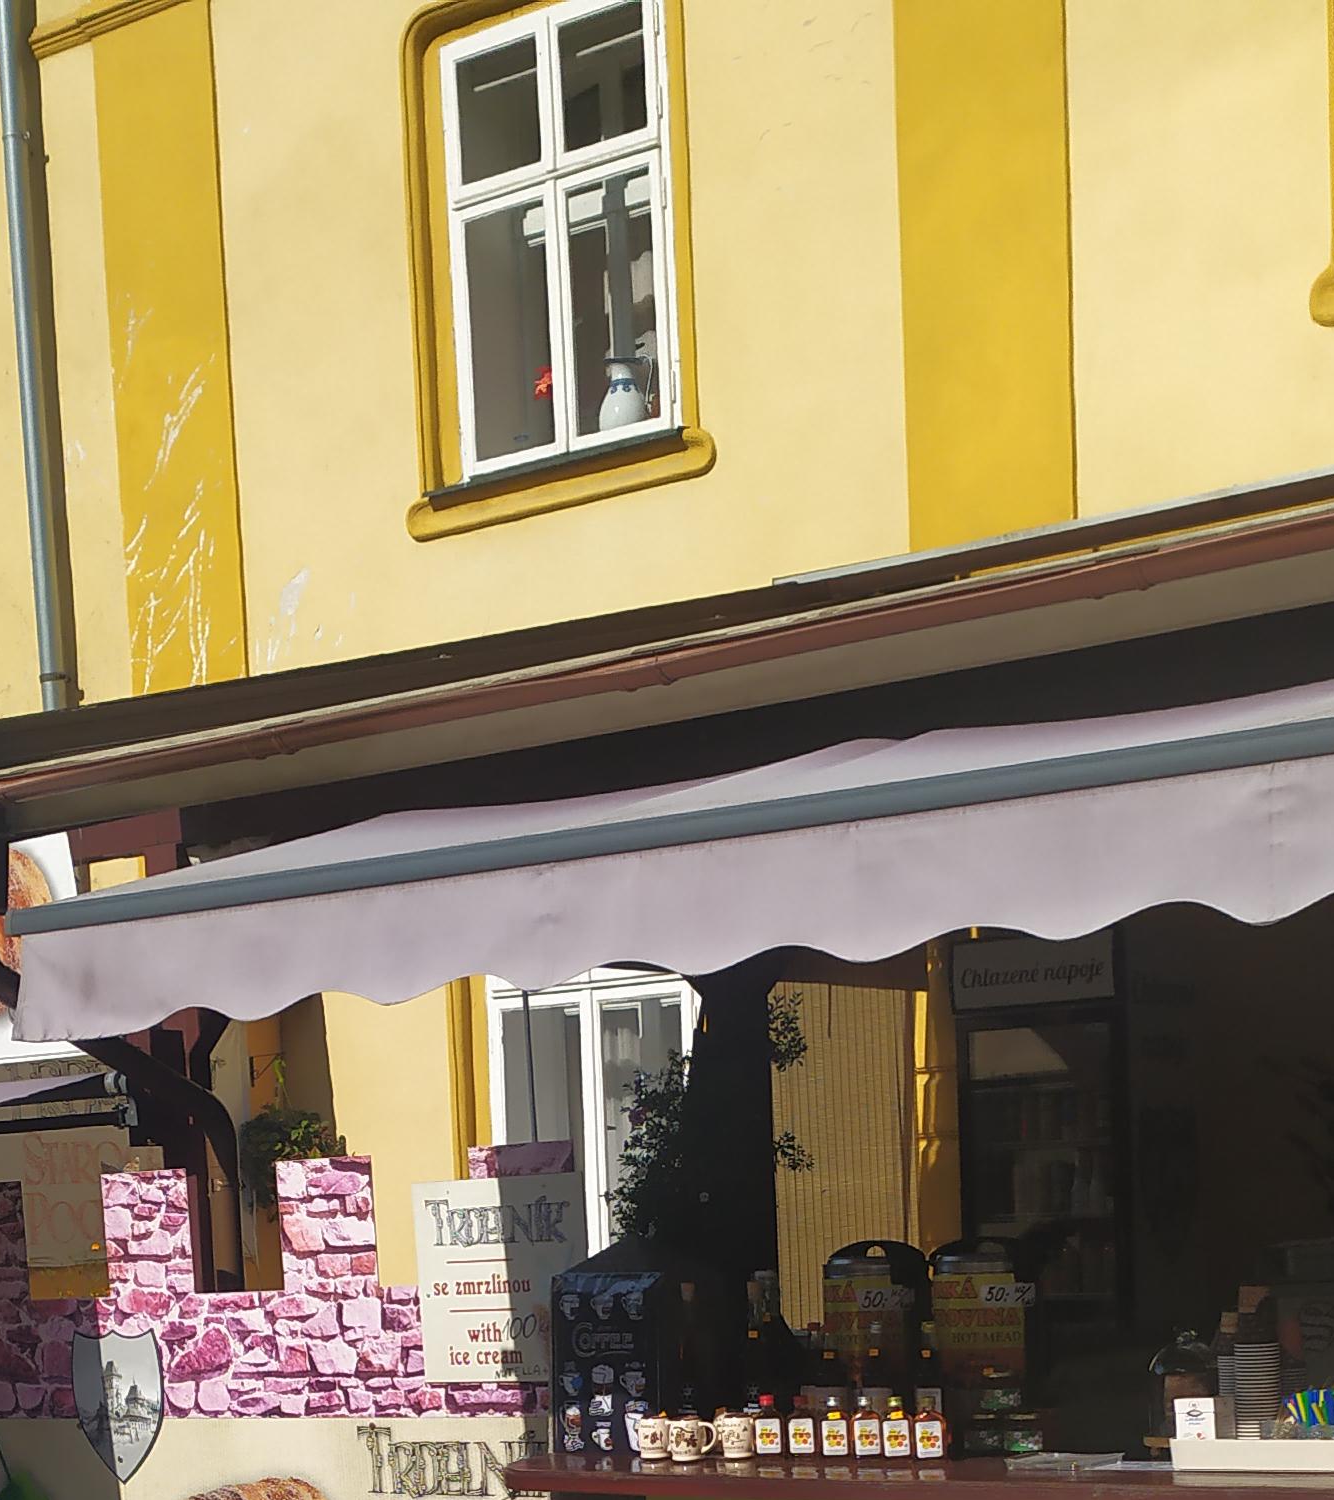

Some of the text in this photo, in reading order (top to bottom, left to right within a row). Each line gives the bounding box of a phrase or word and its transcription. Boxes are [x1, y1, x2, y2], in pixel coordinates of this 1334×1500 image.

[960, 957, 1105, 989] Chlazené nápoje
[433, 1272, 532, 1296] se zmrzlinou
[467, 1321, 502, 1343] with
[502, 1313, 537, 1341] 100
[449, 1347, 523, 1366] ice cream
